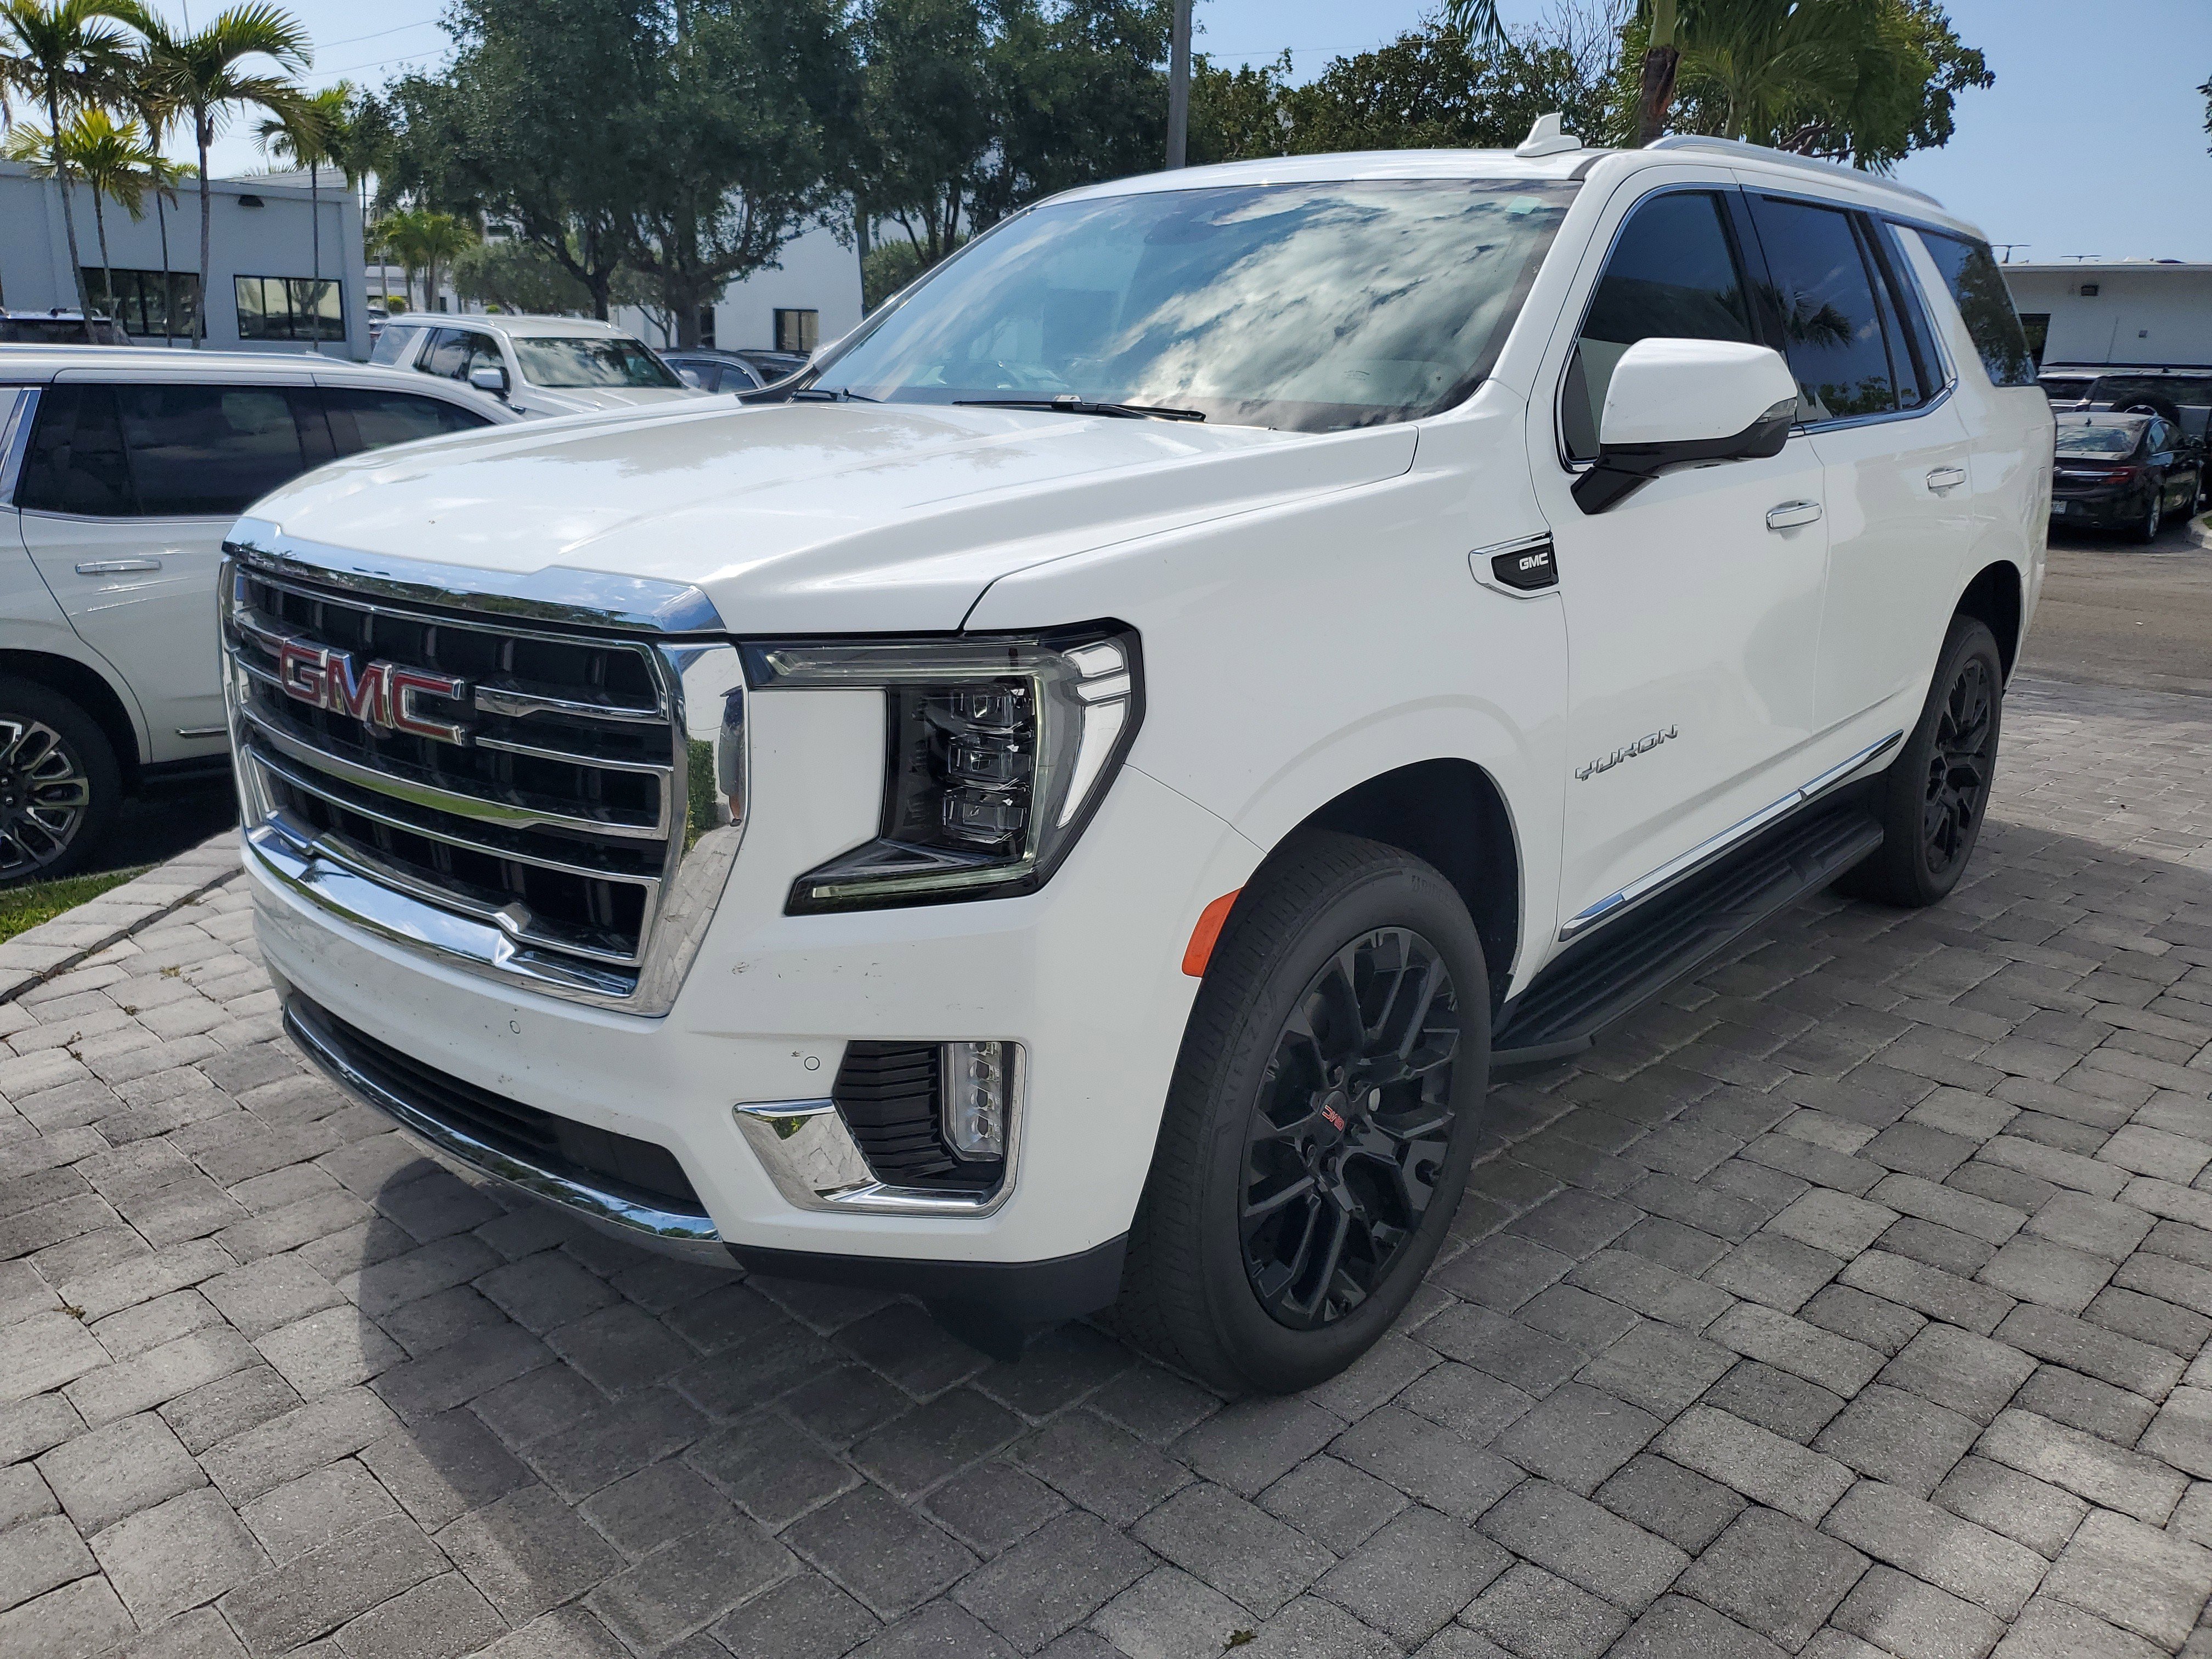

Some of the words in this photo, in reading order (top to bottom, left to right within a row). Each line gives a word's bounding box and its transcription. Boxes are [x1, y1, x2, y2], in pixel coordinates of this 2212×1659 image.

[1519, 552, 1549, 571] GMC
[280, 638, 465, 746] GMC
[1575, 724, 1679, 781] YUKON
[1322, 1104, 1345, 1131] GMC
